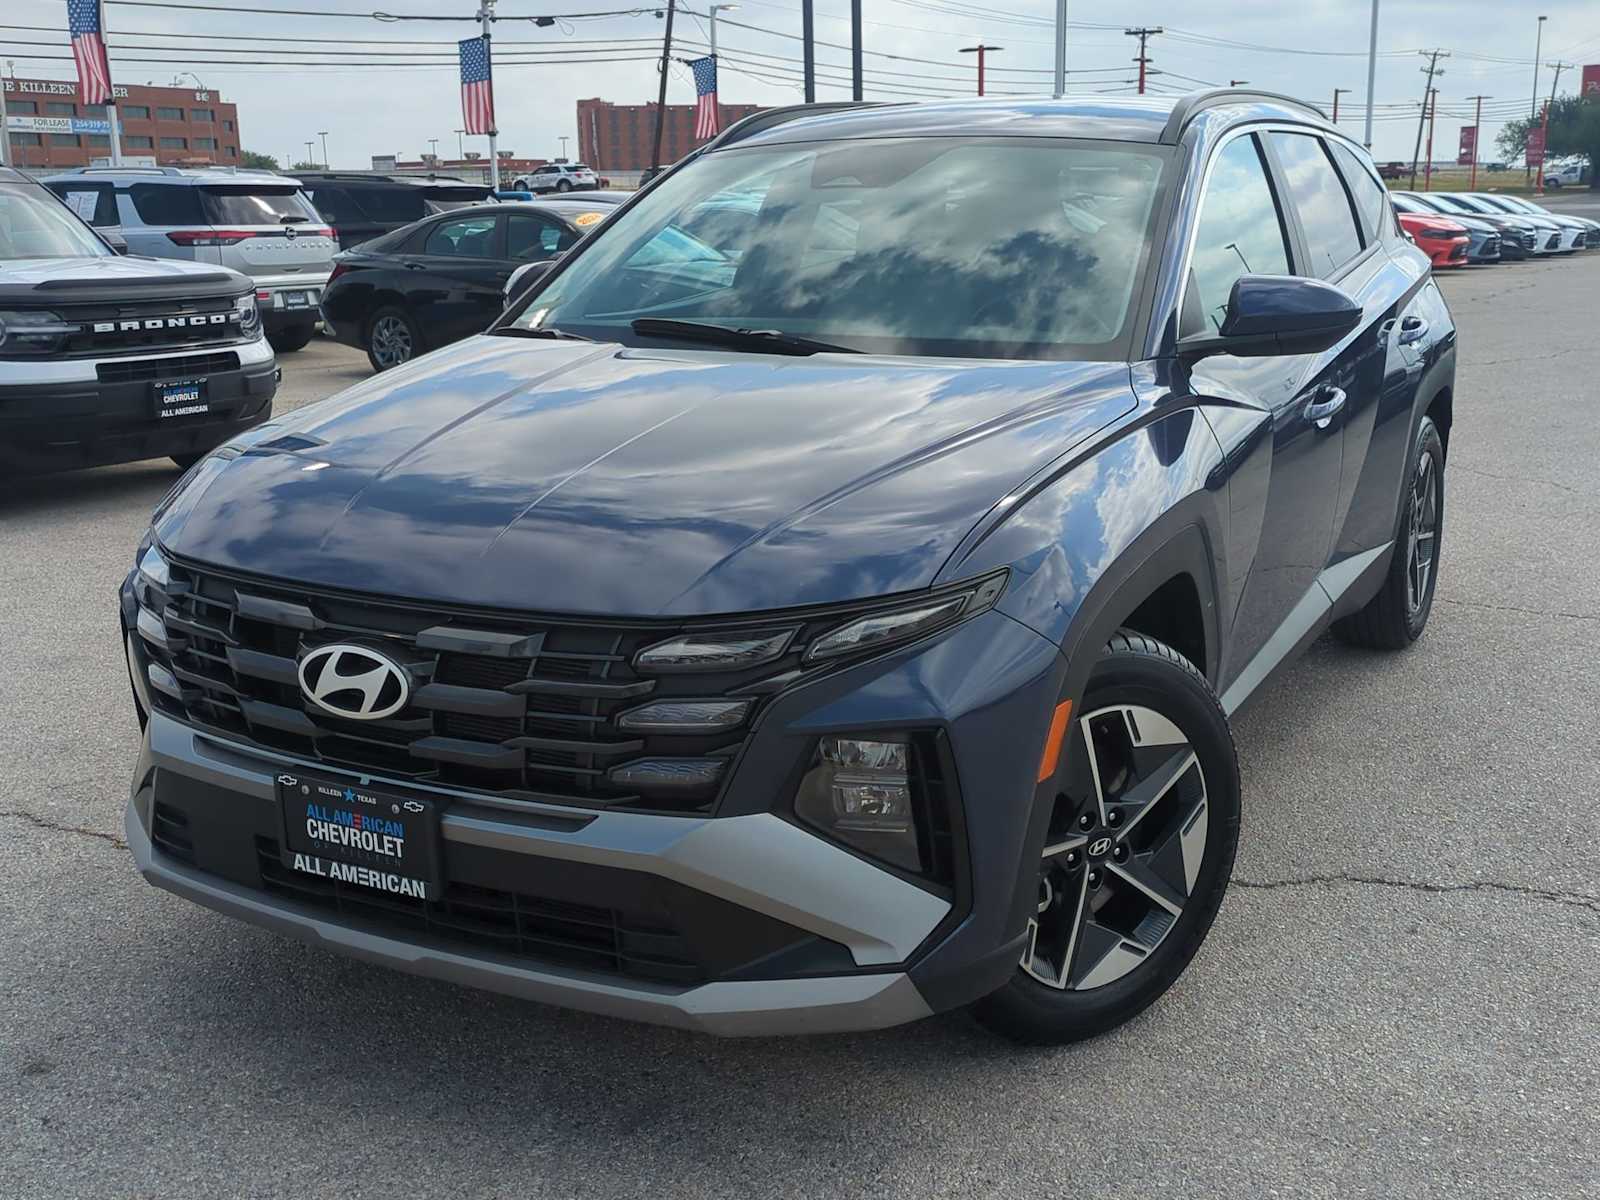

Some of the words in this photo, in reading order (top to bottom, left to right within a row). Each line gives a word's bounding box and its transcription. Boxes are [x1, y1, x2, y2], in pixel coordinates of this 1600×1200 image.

[19, 81, 76, 95] KILLEEN
[33, 118, 48, 127] FOR
[94, 314, 226, 333] BRONCO
[163, 391, 199, 404] CHEVROLET
[161, 409, 174, 418] ALL
[174, 404, 209, 416] AMERICAN
[317, 786, 342, 797] KILLEEN
[356, 794, 377, 805] TEXAS
[306, 803, 332, 822] ALL
[333, 809, 404, 837] AMERICAN
[306, 818, 404, 858] CHEVROLET
[293, 854, 327, 877] ALL
[329, 861, 426, 900] AMERICAN
